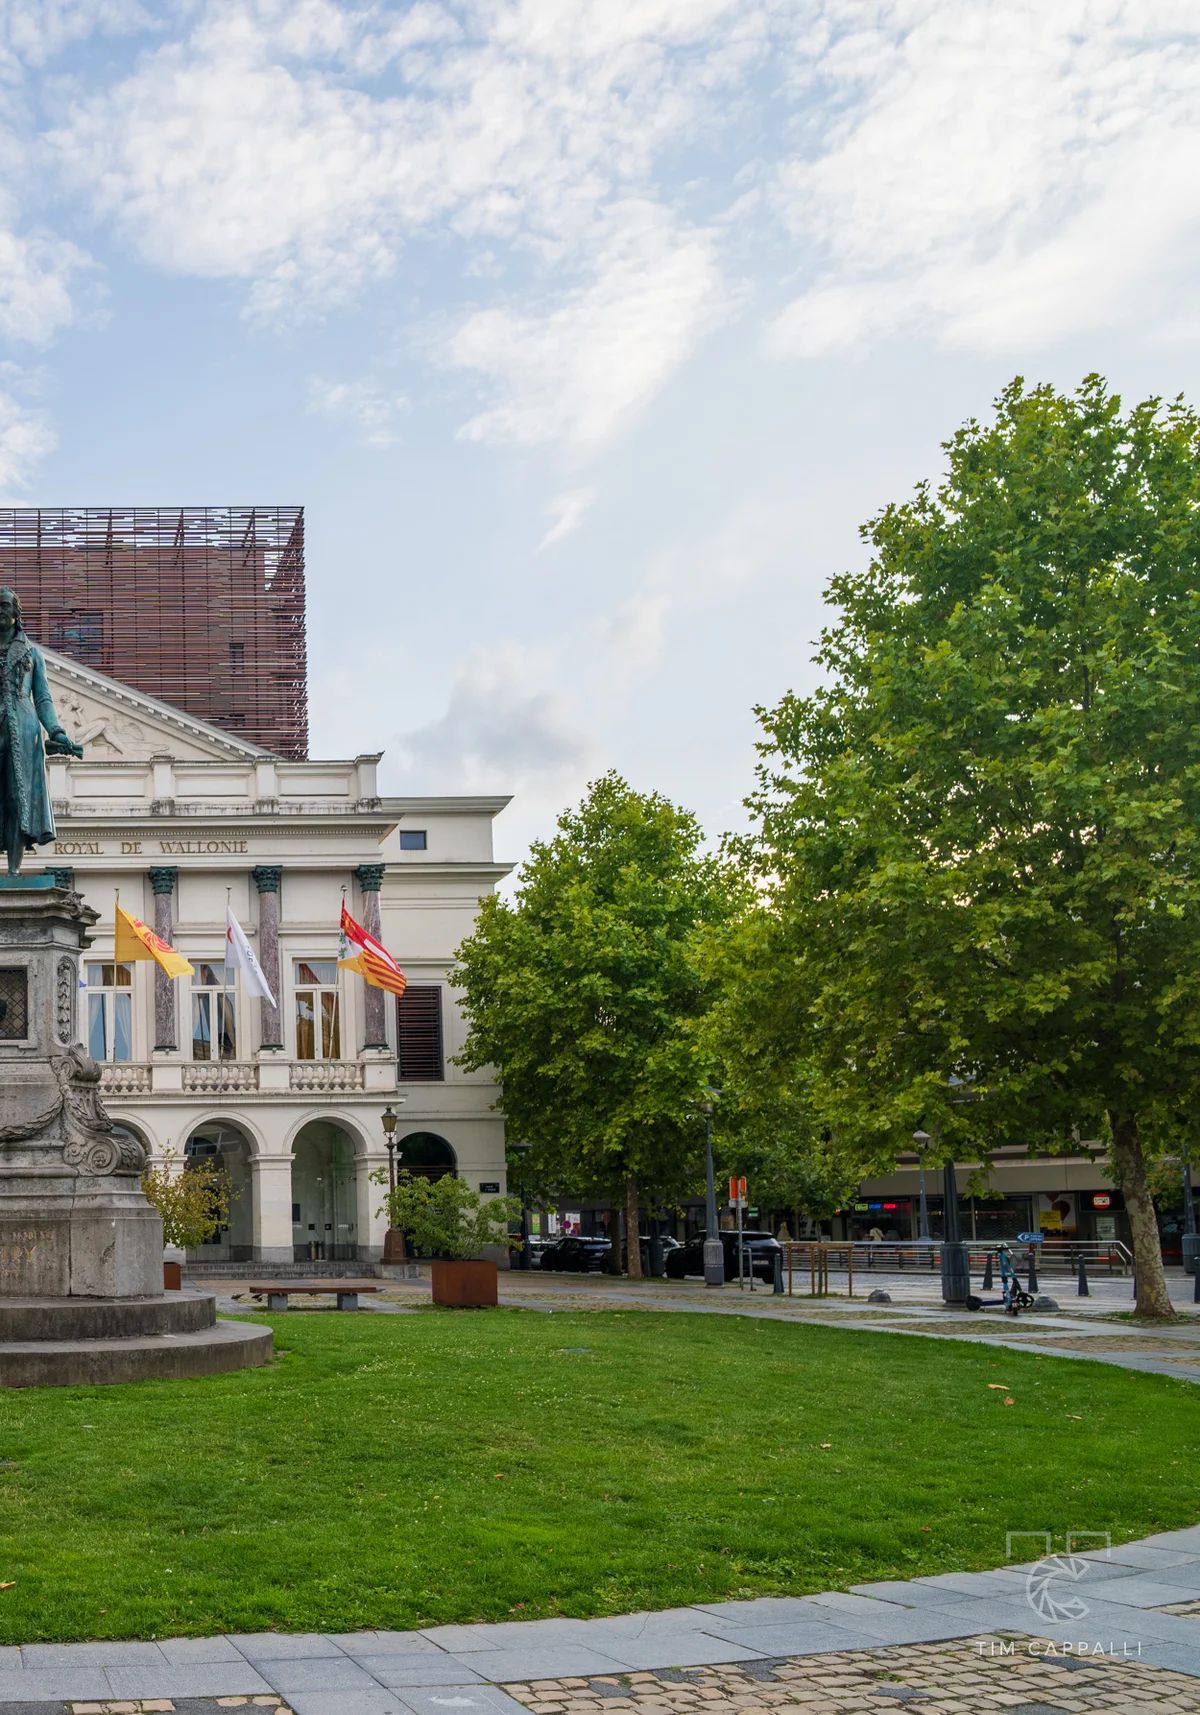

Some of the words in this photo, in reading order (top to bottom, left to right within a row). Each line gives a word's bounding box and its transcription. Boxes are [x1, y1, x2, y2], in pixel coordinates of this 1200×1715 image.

[53, 842, 104, 854] ROYAL
[121, 842, 142, 854] DE
[160, 841, 248, 854] WALLONIE
